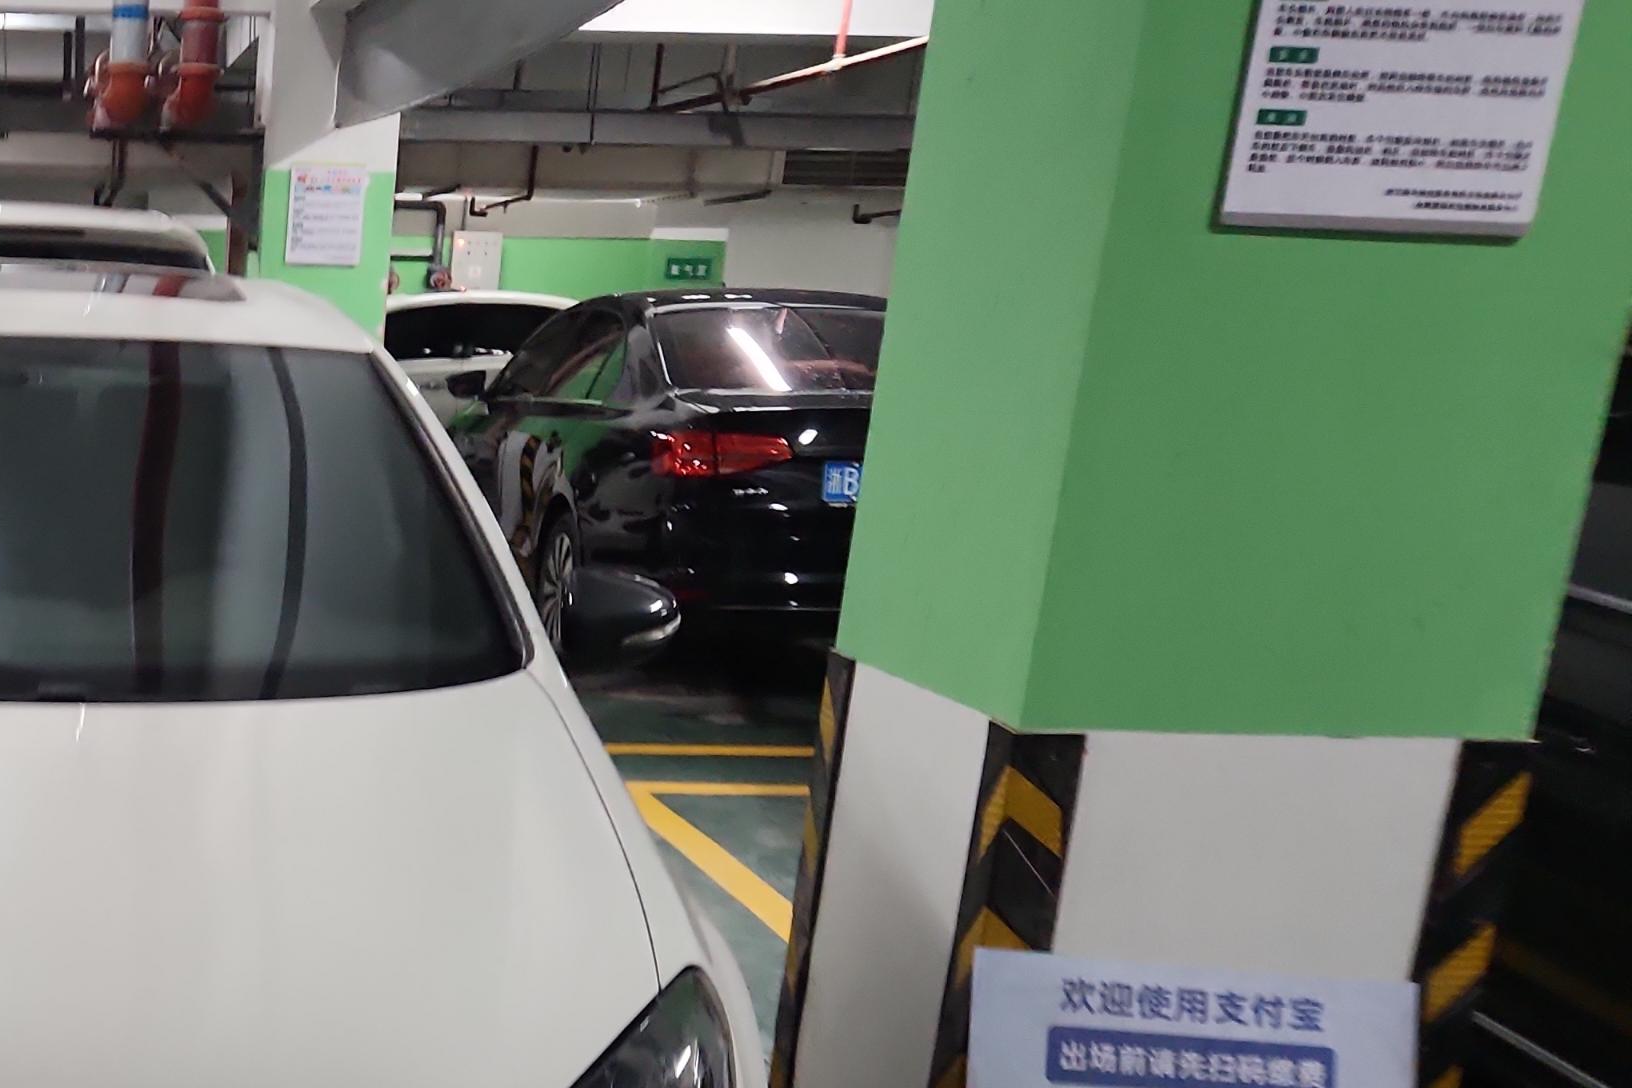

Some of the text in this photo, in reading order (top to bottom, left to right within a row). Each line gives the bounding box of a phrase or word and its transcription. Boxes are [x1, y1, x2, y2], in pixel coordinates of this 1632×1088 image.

[1060, 977, 1325, 1032] 欢迎使用支付宝
